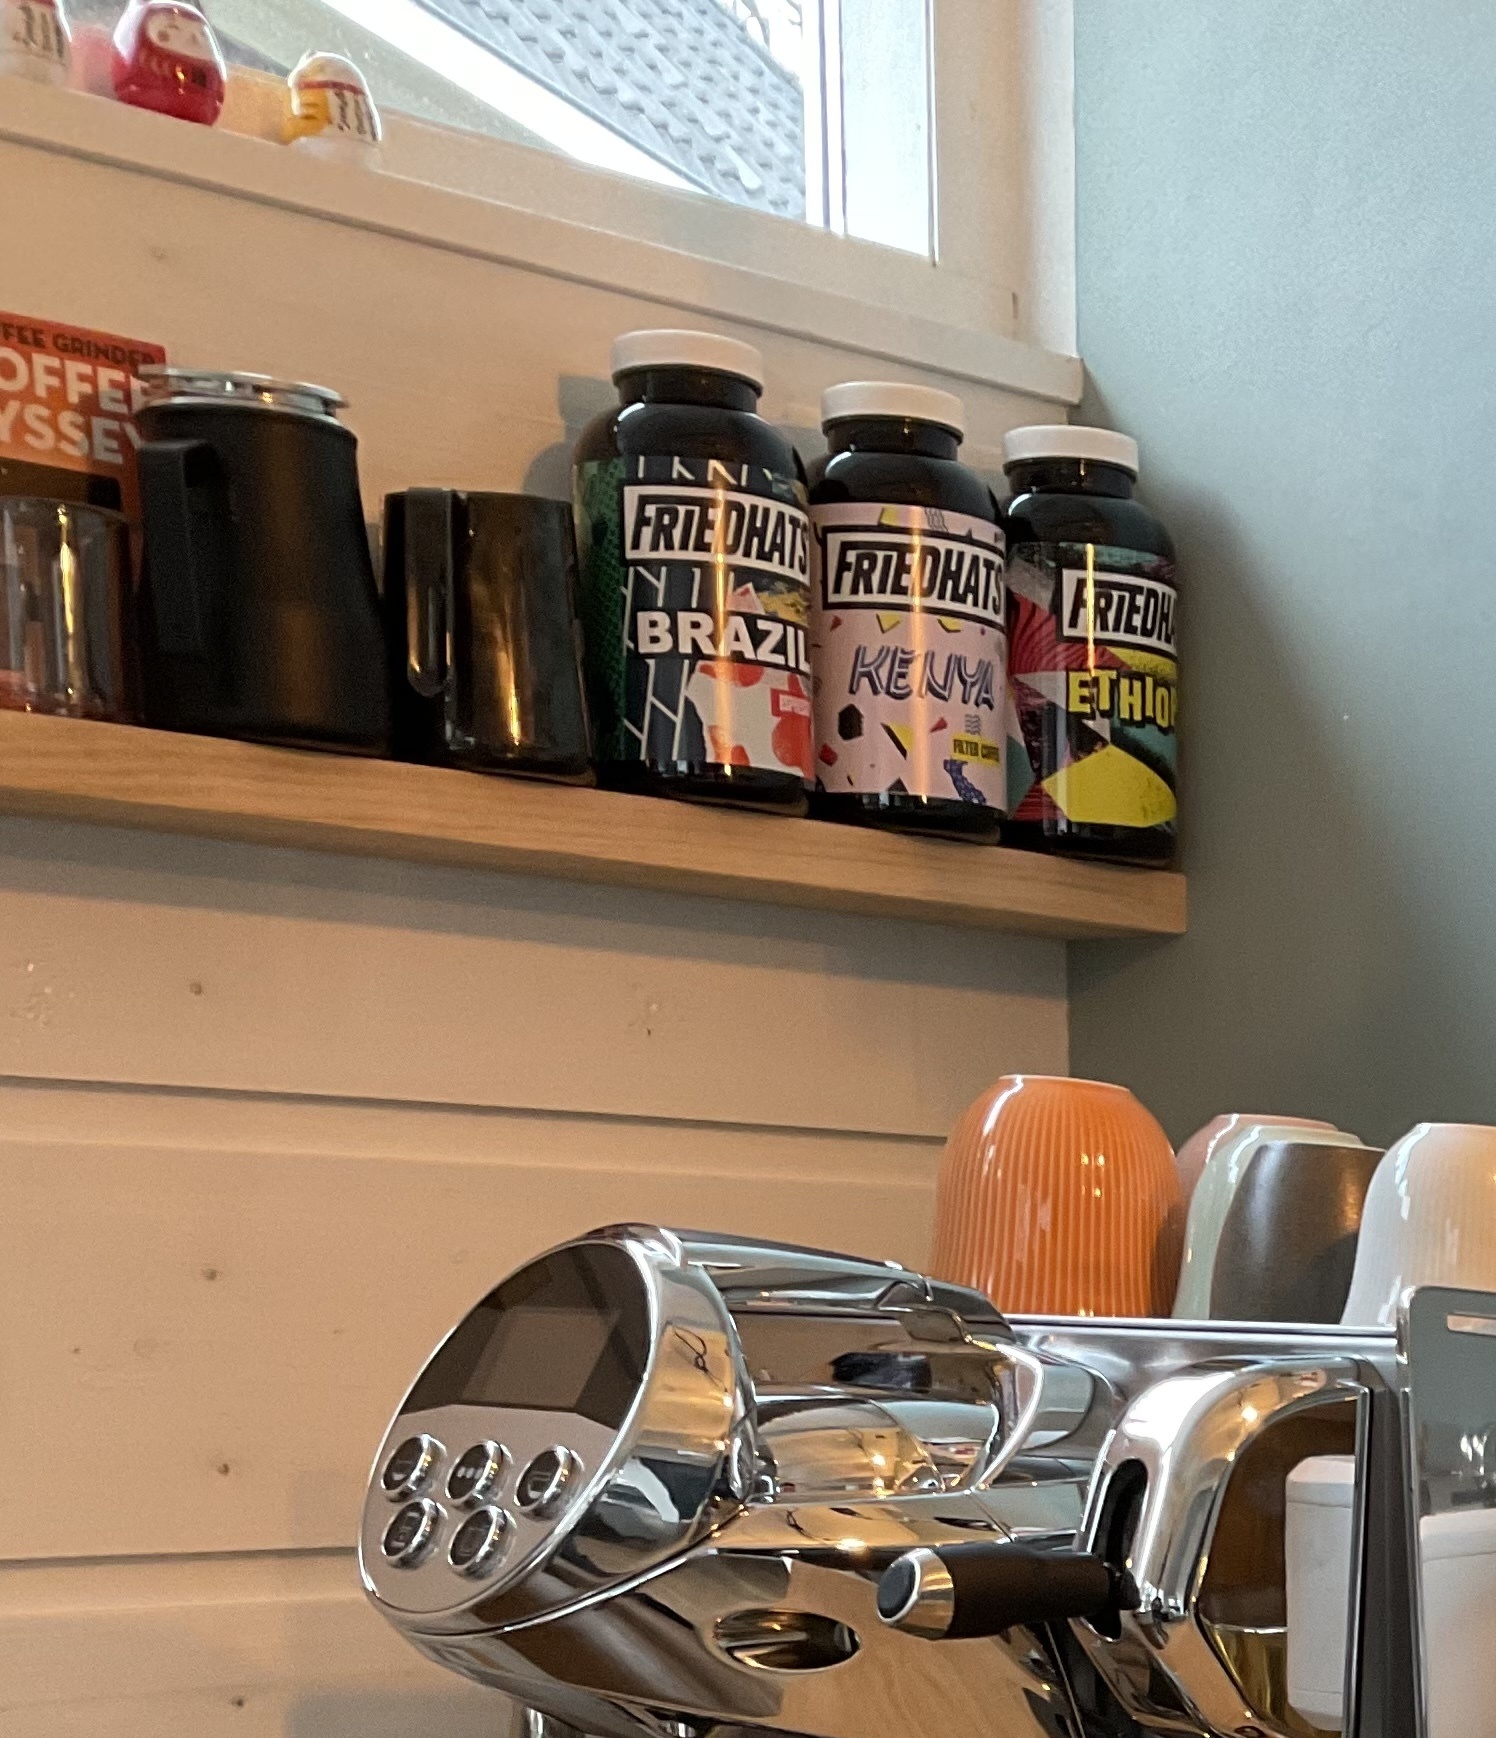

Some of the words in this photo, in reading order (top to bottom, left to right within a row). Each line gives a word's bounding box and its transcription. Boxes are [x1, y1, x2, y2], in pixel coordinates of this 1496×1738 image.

[0, 323, 46, 349] FEE
[631, 493, 810, 576] FRIEDHATS
[832, 540, 1003, 616] FRIEDHATS
[1068, 577, 1175, 645] FRIEDH
[636, 610, 812, 674] BRAZIL
[848, 643, 995, 712] KENYA
